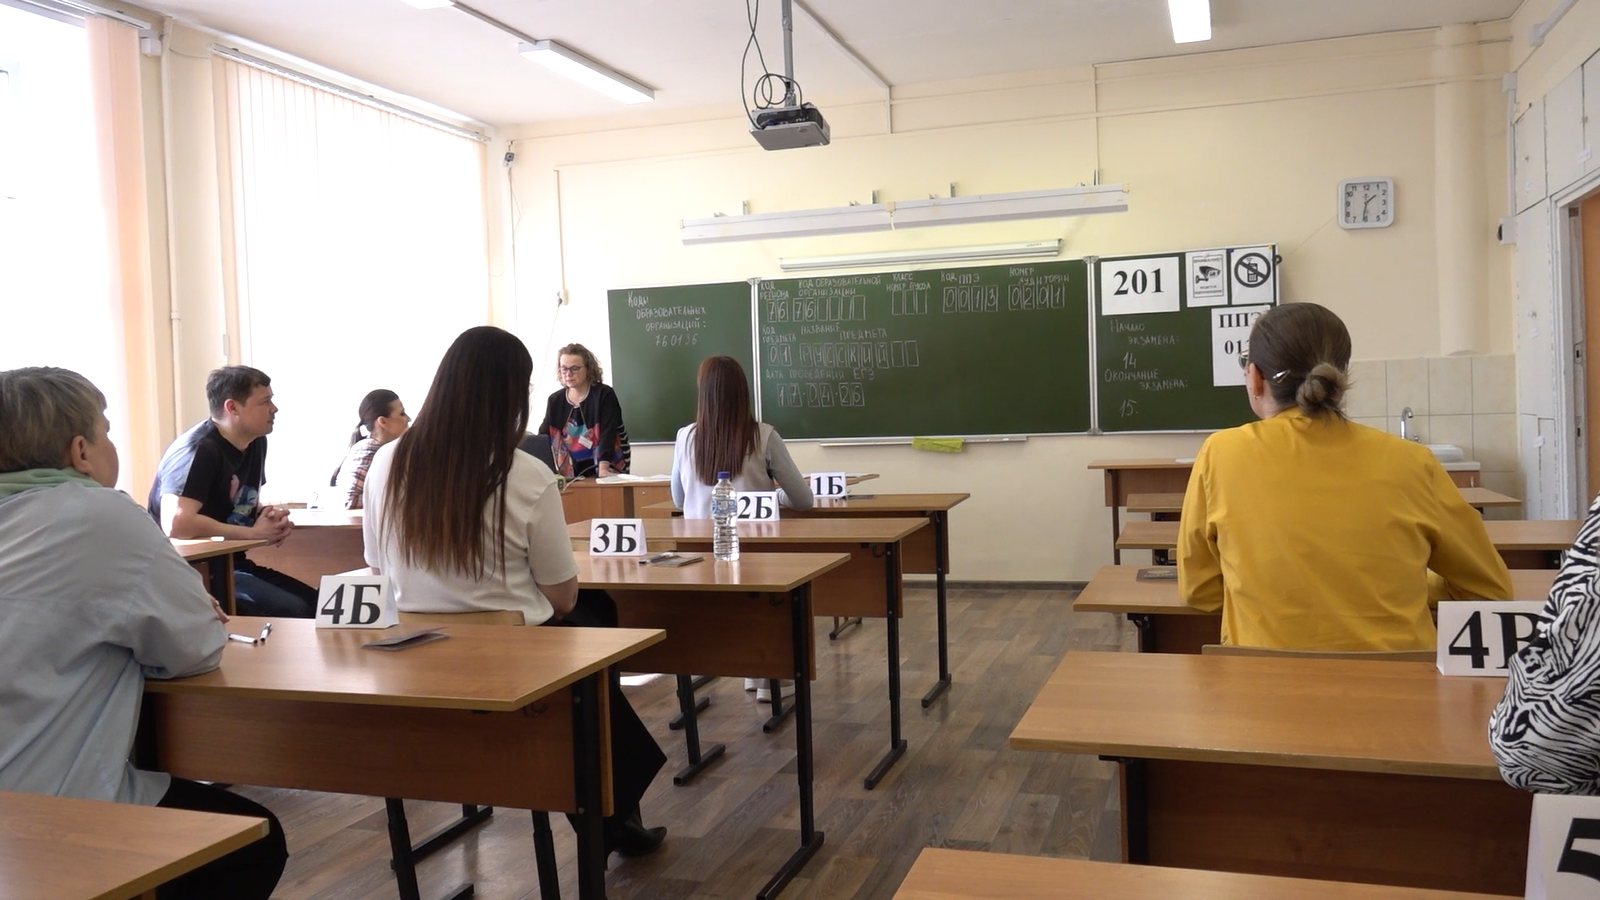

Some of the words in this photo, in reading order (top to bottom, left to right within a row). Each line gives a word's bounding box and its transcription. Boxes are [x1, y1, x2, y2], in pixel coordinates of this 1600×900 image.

[958, 274, 980, 284] ППЭ
[1010, 268, 1035, 277] НОМЕР
[1113, 268, 1164, 295] 201
[798, 280, 814, 288] КОД
[768, 301, 786, 320] 76
[795, 300, 814, 318] 76
[840, 328, 888, 340] ПРЕДМЕТА
[1224, 340, 1250, 355] 01
[1122, 352, 1137, 370] 14
[853, 368, 874, 380] ЕГЭ
[814, 476, 843, 496] 1Б
[738, 496, 773, 519] 2Б
[592, 523, 637, 553] 3Б
[320, 584, 382, 625] 4Б
